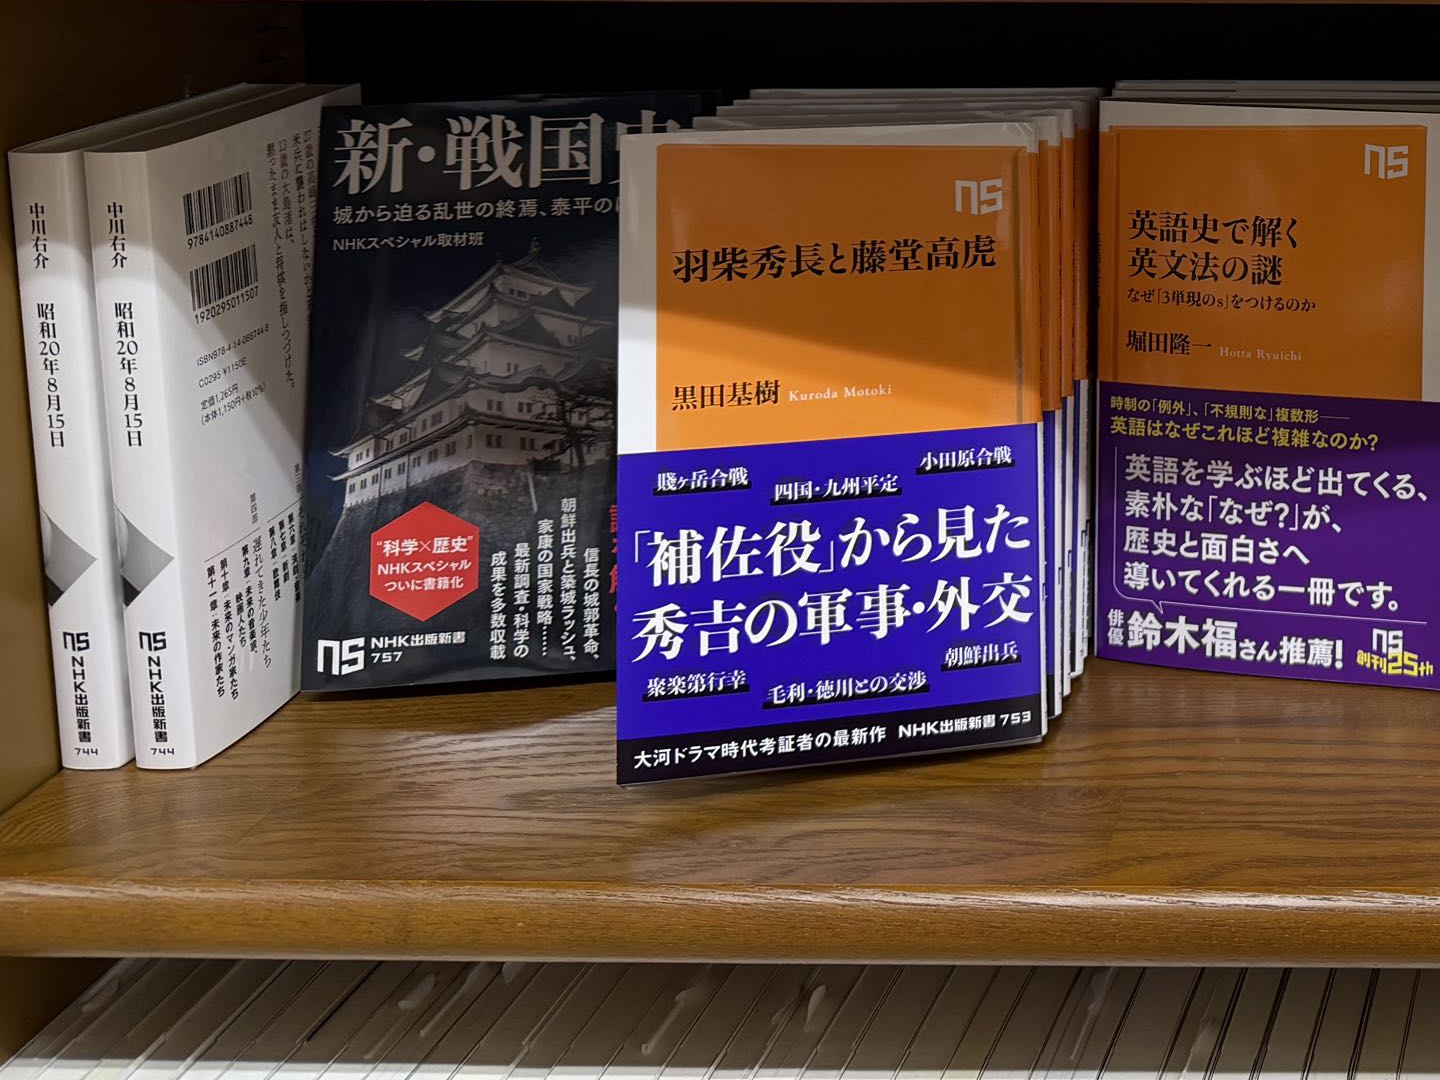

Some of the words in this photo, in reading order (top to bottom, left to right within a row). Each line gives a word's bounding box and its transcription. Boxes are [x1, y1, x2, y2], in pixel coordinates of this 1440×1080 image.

[29, 202, 49, 269] 中川右介
[107, 202, 127, 269] 中川右介
[187, 214, 254, 250] 9784140887448
[333, 232, 484, 251] NHKスペシャル取材班
[1128, 209, 1298, 248] 英語史で解く
[673, 234, 996, 284] 羽柴秀長と藤堂高虎
[1128, 248, 1282, 286] 英文法の謎
[194, 286, 259, 325] 1920295011507
[1128, 288, 1315, 312] なぜ「3単現のs」をつけるのか
[1126, 330, 1212, 356] 堀田隆一
[1220, 346, 1251, 359] Hotta
[1257, 349, 1302, 361] Ryuichi
[37, 302, 65, 448] 昭和20年8月15日
[114, 302, 143, 448] 昭和20年8月15日
[789, 387, 838, 402] Kuroda
[844, 384, 891, 397] Motoki
[671, 380, 781, 411] 黒田基樹
[919, 446, 1012, 471] 小田原合戦
[775, 474, 898, 501] 四国・九州平定
[1126, 454, 1428, 501] 英語を学ぶほど出てくる、
[633, 503, 1031, 588] 「補佐役」から見た
[1124, 526, 1310, 564] 歴史と面白さへ
[378, 560, 471, 575] NHKスペシャル
[384, 577, 463, 592] ついに書籍化
[560, 497, 577, 661] 朝鮮出兵と築城ラッシュ、
[490, 551, 507, 659] 成果を多数収載
[514, 543, 530, 658] 最新調査・科学の
[583, 548, 600, 660] 信長の城郭革命、
[1124, 562, 1398, 611] 導いてくれる一冊です。
[632, 572, 1033, 663] 秀吉の軍事・外交
[371, 631, 465, 649] NHK出版新書
[371, 651, 402, 663] 757
[944, 644, 1018, 668] 朝鮮出兵
[1357, 649, 1434, 676] 創刊25th
[647, 671, 746, 698] 聚楽第行幸
[768, 672, 928, 705] 毛利・徳川との交渉
[150, 748, 175, 756] 744
[634, 726, 886, 768] 大河ドラマ時代考証者の最新作
[898, 714, 996, 738] NHK出版新書
[1000, 711, 1031, 727] 753
